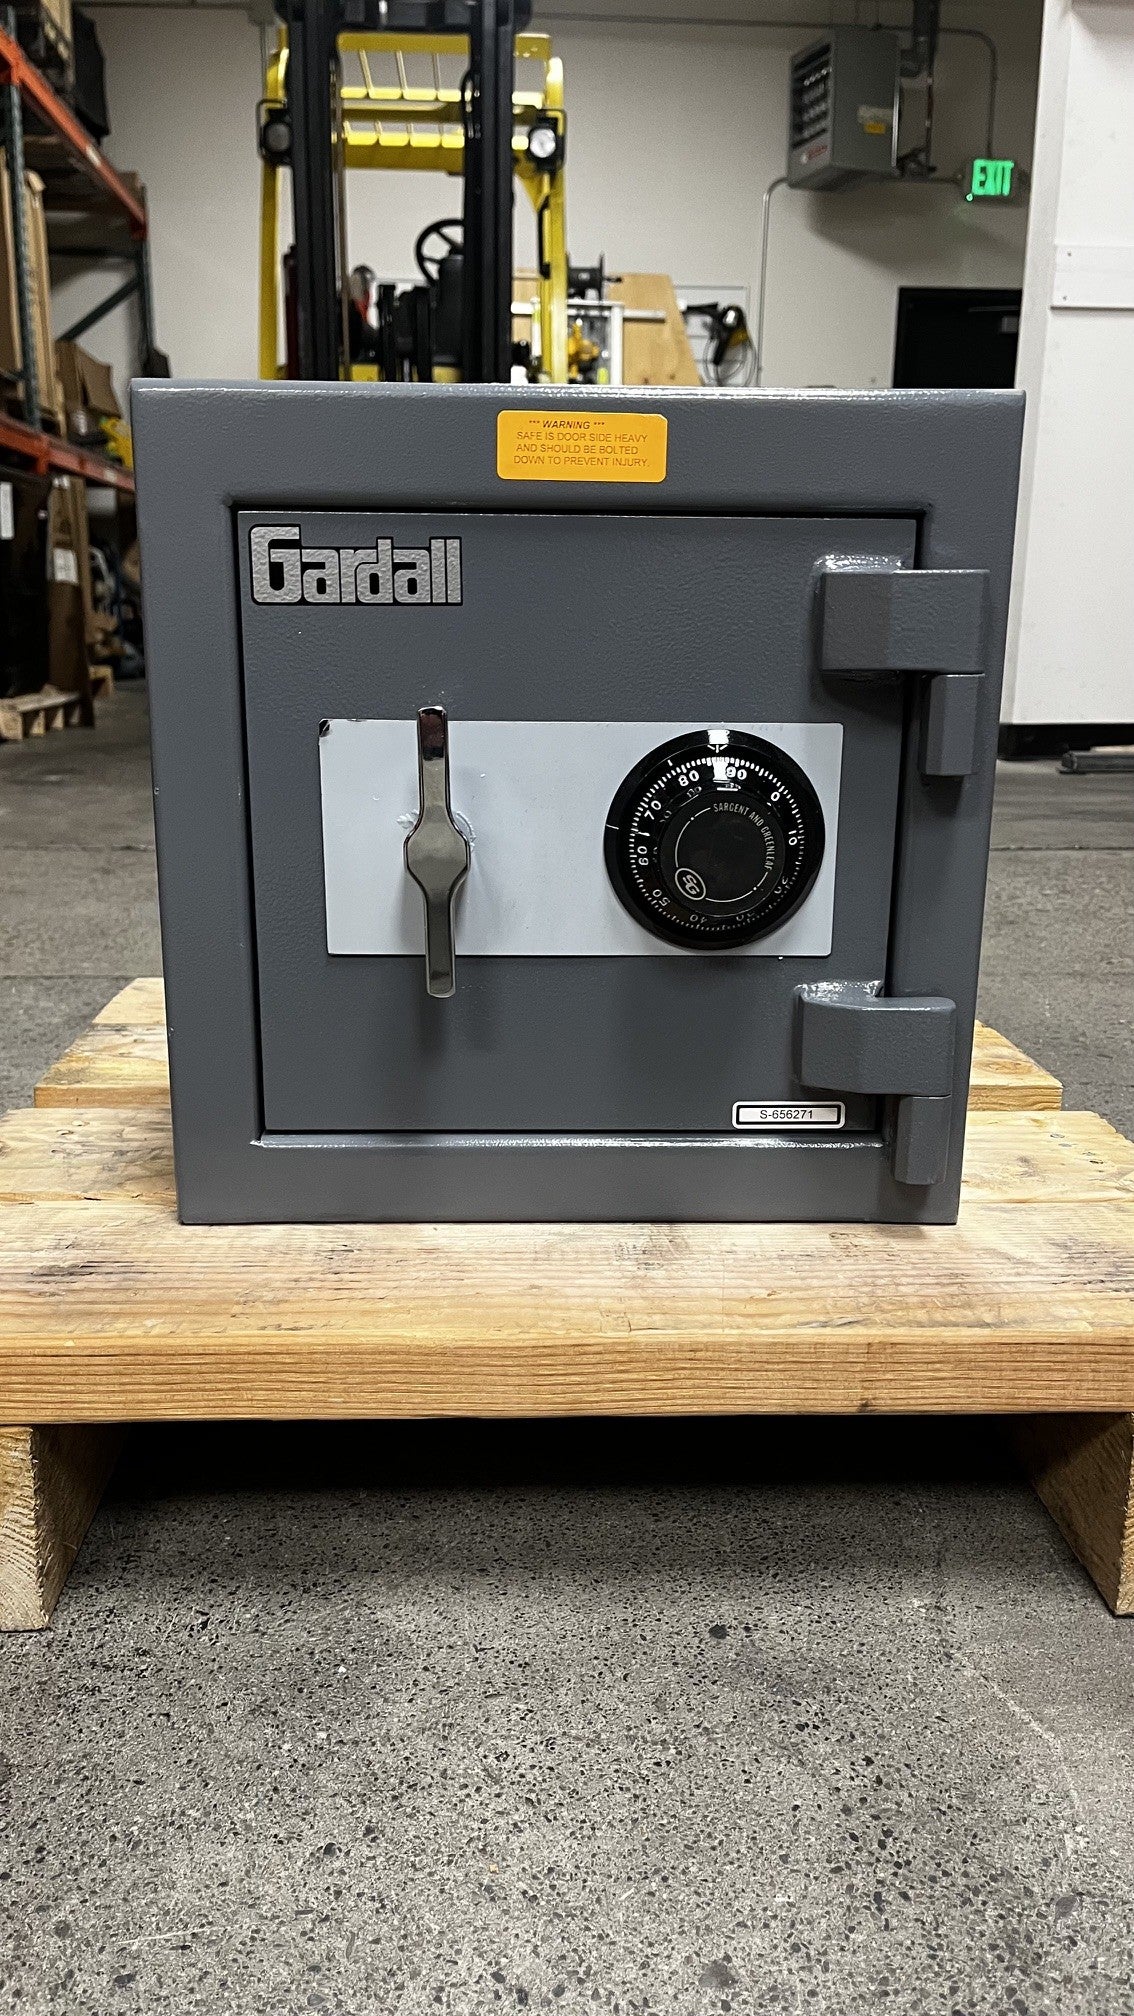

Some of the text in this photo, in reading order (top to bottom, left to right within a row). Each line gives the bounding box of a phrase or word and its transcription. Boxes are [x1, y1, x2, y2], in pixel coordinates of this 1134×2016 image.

[972, 159, 1014, 196] EXIT
[542, 420, 591, 430] WARNING
[516, 431, 648, 443] SAFE IS DOOR SIDE HEAVY
[516, 444, 638, 455] AND SHOULD BE BOLTED
[513, 455, 650, 467] DOWN TO PREVENT INJURY.
[249, 525, 462, 605] Gardall
[678, 769, 700, 787] 80
[726, 766, 747, 780] 90
[644, 800, 662, 820] 70
[713, 802, 775, 871] SARGENT AND GREENLEAF
[788, 830, 798, 846] 10
[637, 846, 649, 866] 60
[652, 889, 671, 907] 50
[759, 1109, 813, 1120] S-656271
